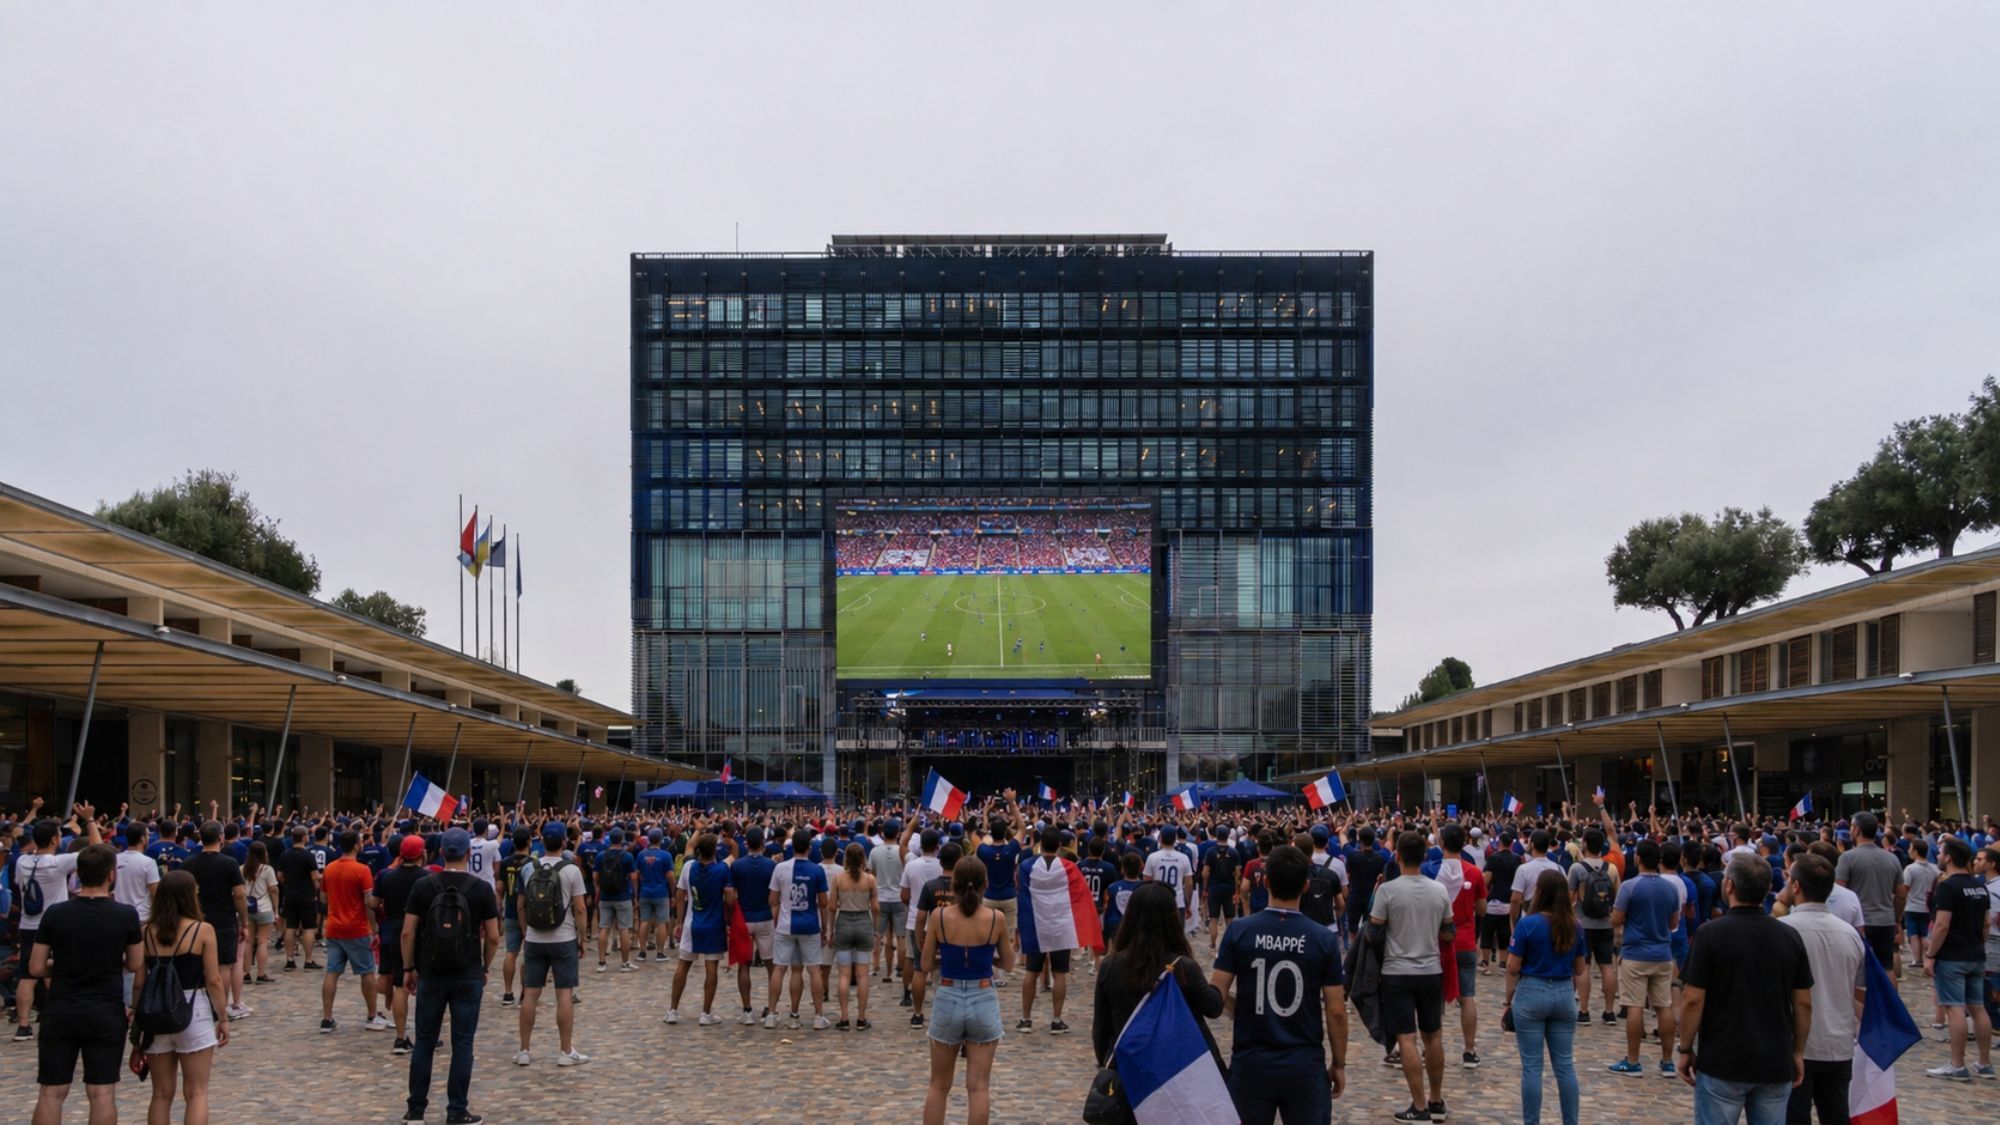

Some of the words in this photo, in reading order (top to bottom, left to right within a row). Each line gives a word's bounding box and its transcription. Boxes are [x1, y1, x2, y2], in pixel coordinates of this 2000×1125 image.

[1159, 865, 1178, 887] 10
[1255, 934, 1306, 954] MBAPPÉ
[1250, 958, 1304, 1017] 10
